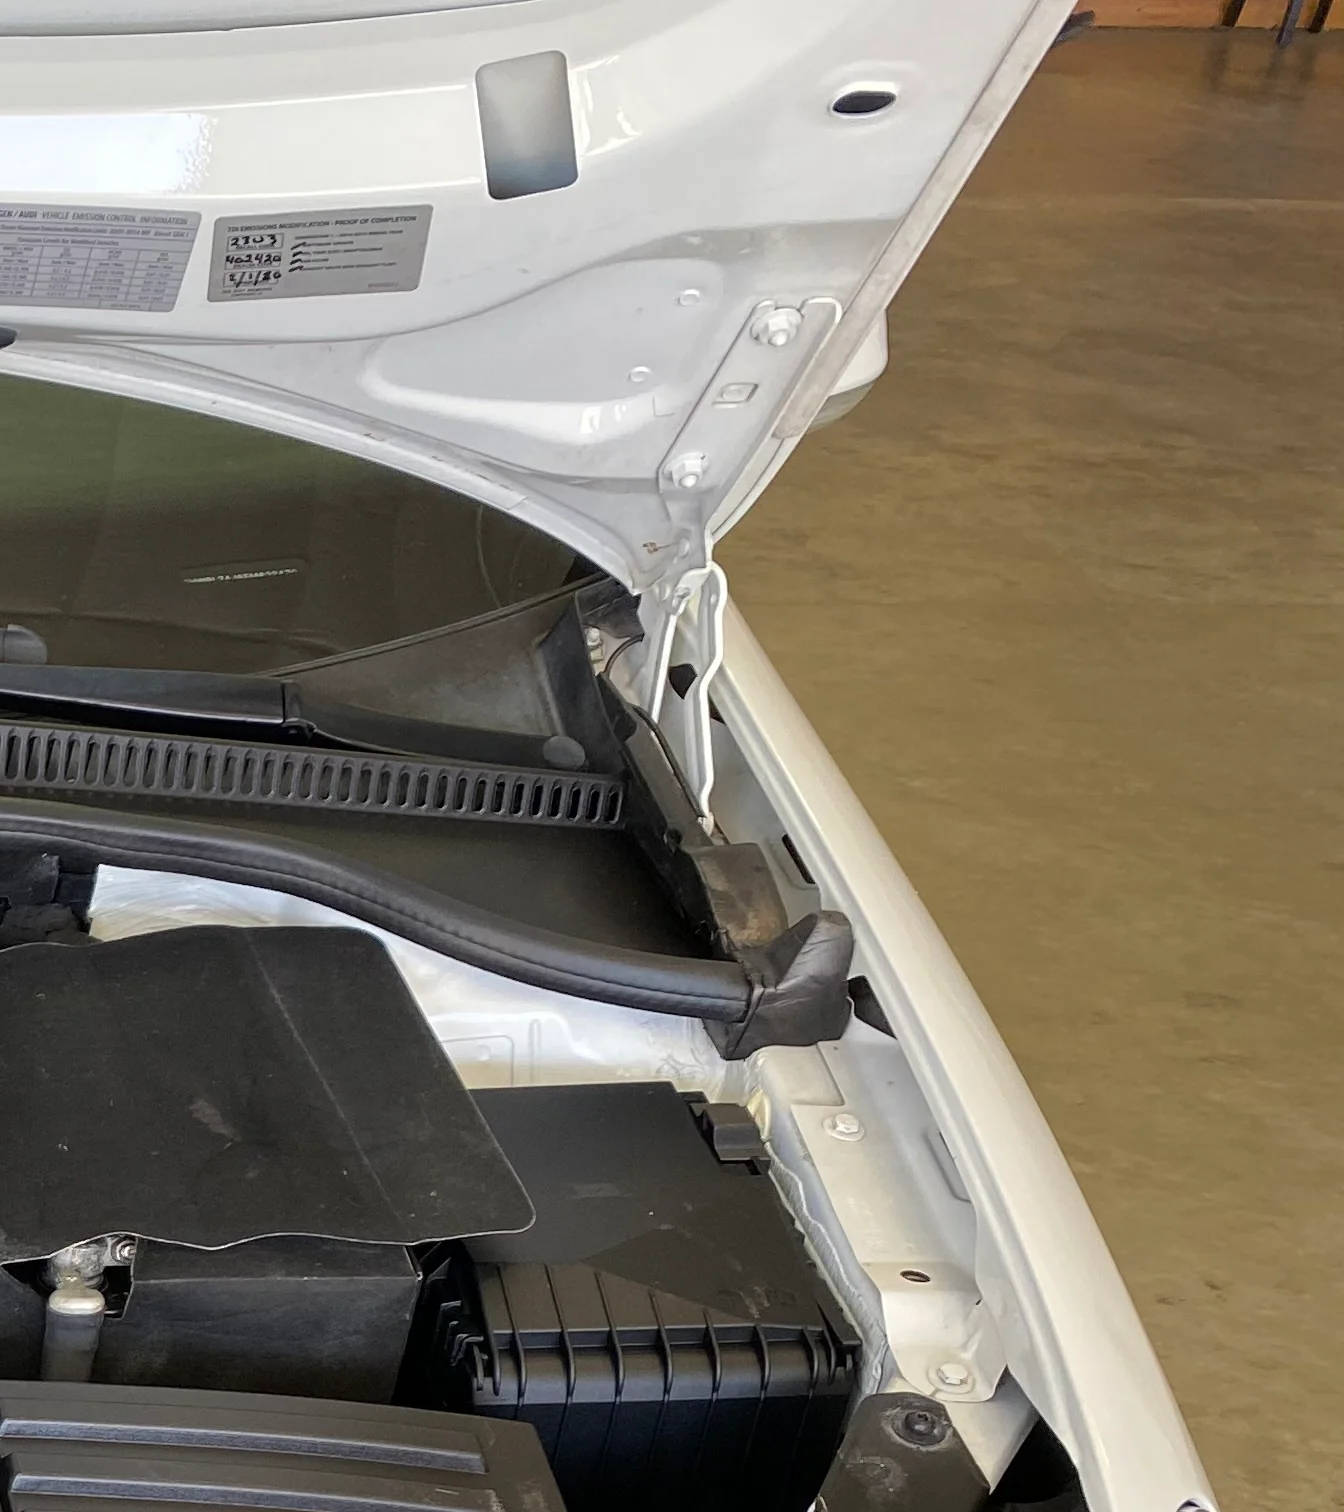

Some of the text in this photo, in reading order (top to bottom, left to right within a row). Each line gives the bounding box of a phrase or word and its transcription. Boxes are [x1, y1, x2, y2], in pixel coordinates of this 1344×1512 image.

[42, 211, 69, 220] VEHICLE
[106, 214, 136, 223] CONTROL
[140, 216, 188, 225] INFORMATION
[240, 224, 277, 232] EMISSIONS
[278, 221, 329, 229] MODIFICATION
